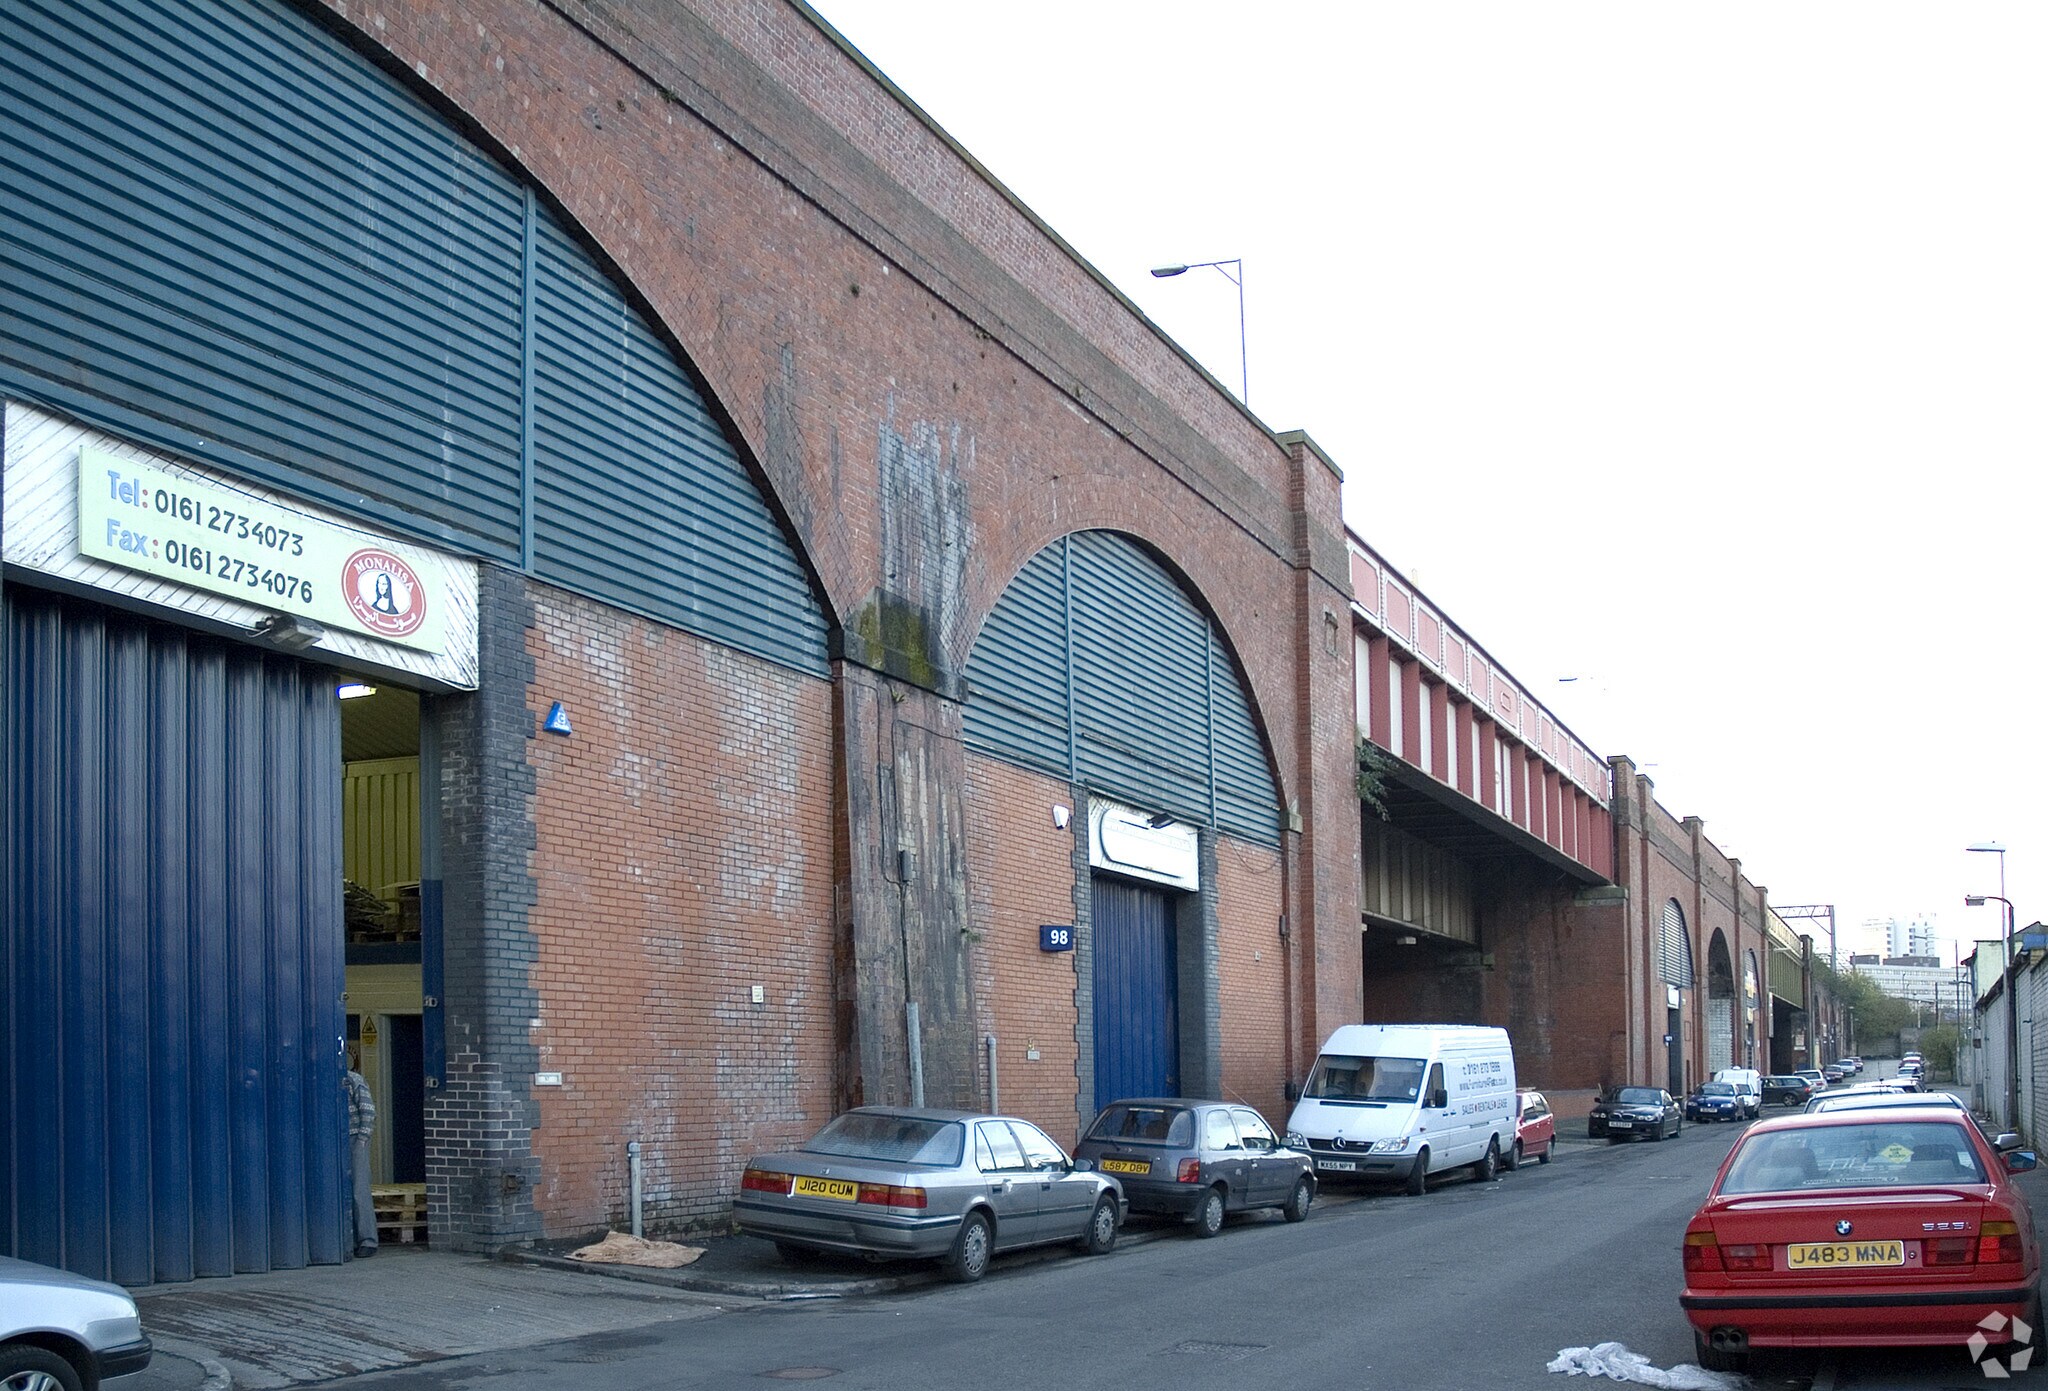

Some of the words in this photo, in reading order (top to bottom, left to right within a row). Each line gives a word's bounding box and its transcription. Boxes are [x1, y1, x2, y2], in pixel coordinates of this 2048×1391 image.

[107, 470, 148, 508] Tel:
[155, 489, 201, 525] 0161
[208, 506, 304, 556] 2734073
[165, 540, 211, 575] 0161
[218, 555, 313, 603] 2734076
[354, 557, 415, 593] MONALISA
[1050, 929, 1069, 945] 98
[799, 1180, 826, 1193] J120
[828, 1183, 854, 1196] CUM
[1793, 1246, 1850, 1264] J483
[1856, 1245, 1900, 1262] MNA
